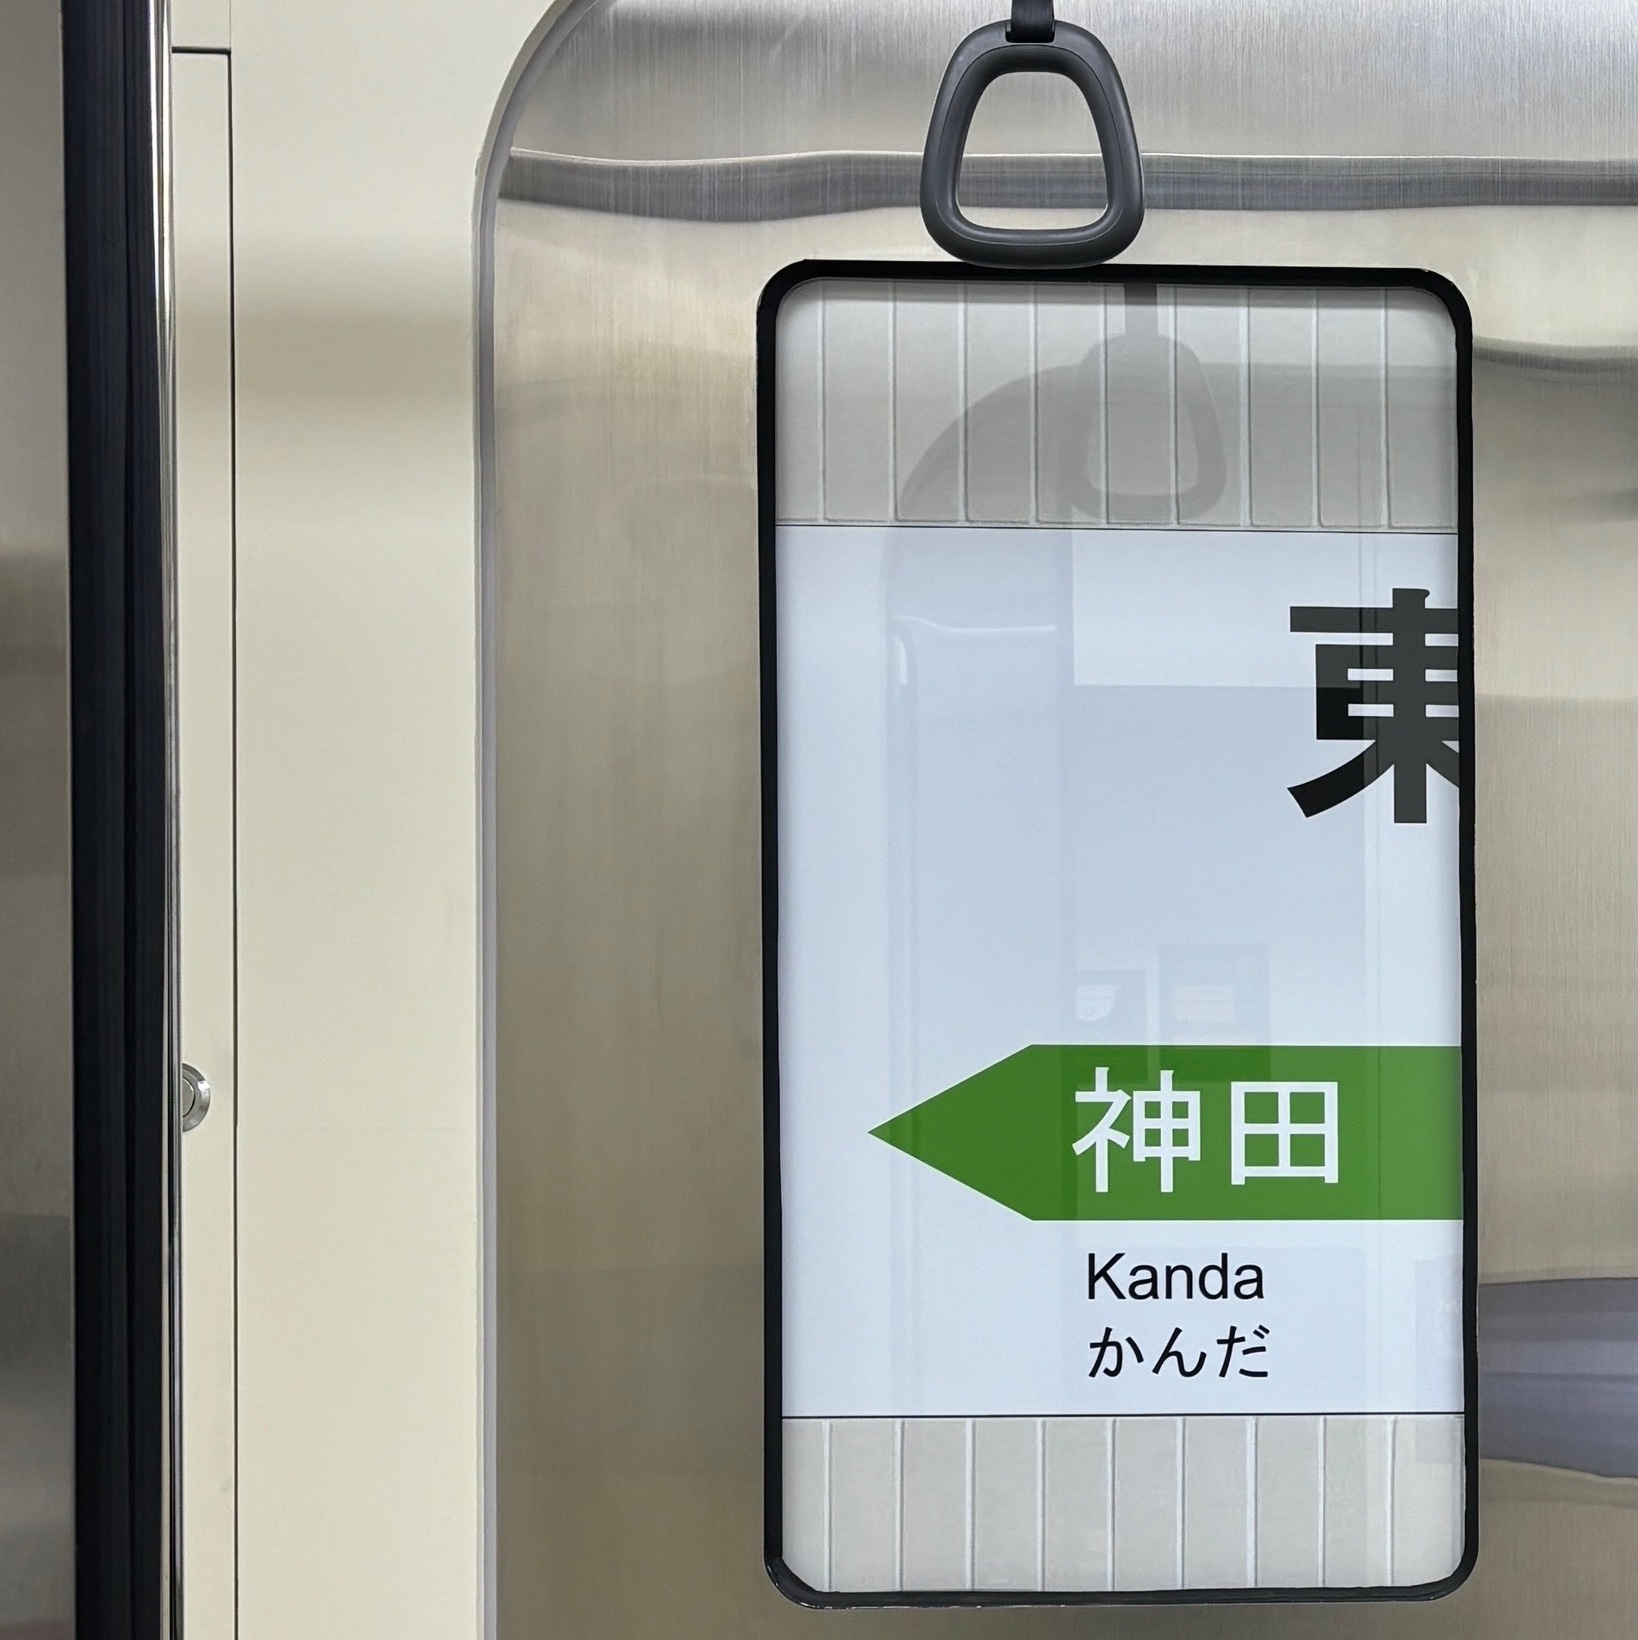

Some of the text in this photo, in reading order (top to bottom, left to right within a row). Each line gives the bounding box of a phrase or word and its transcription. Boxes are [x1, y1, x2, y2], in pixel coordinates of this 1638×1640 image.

[1071, 1066, 1340, 1194] 神田
[1087, 1252, 1266, 1301] Kanda
[1087, 1324, 1271, 1378] かんだ
